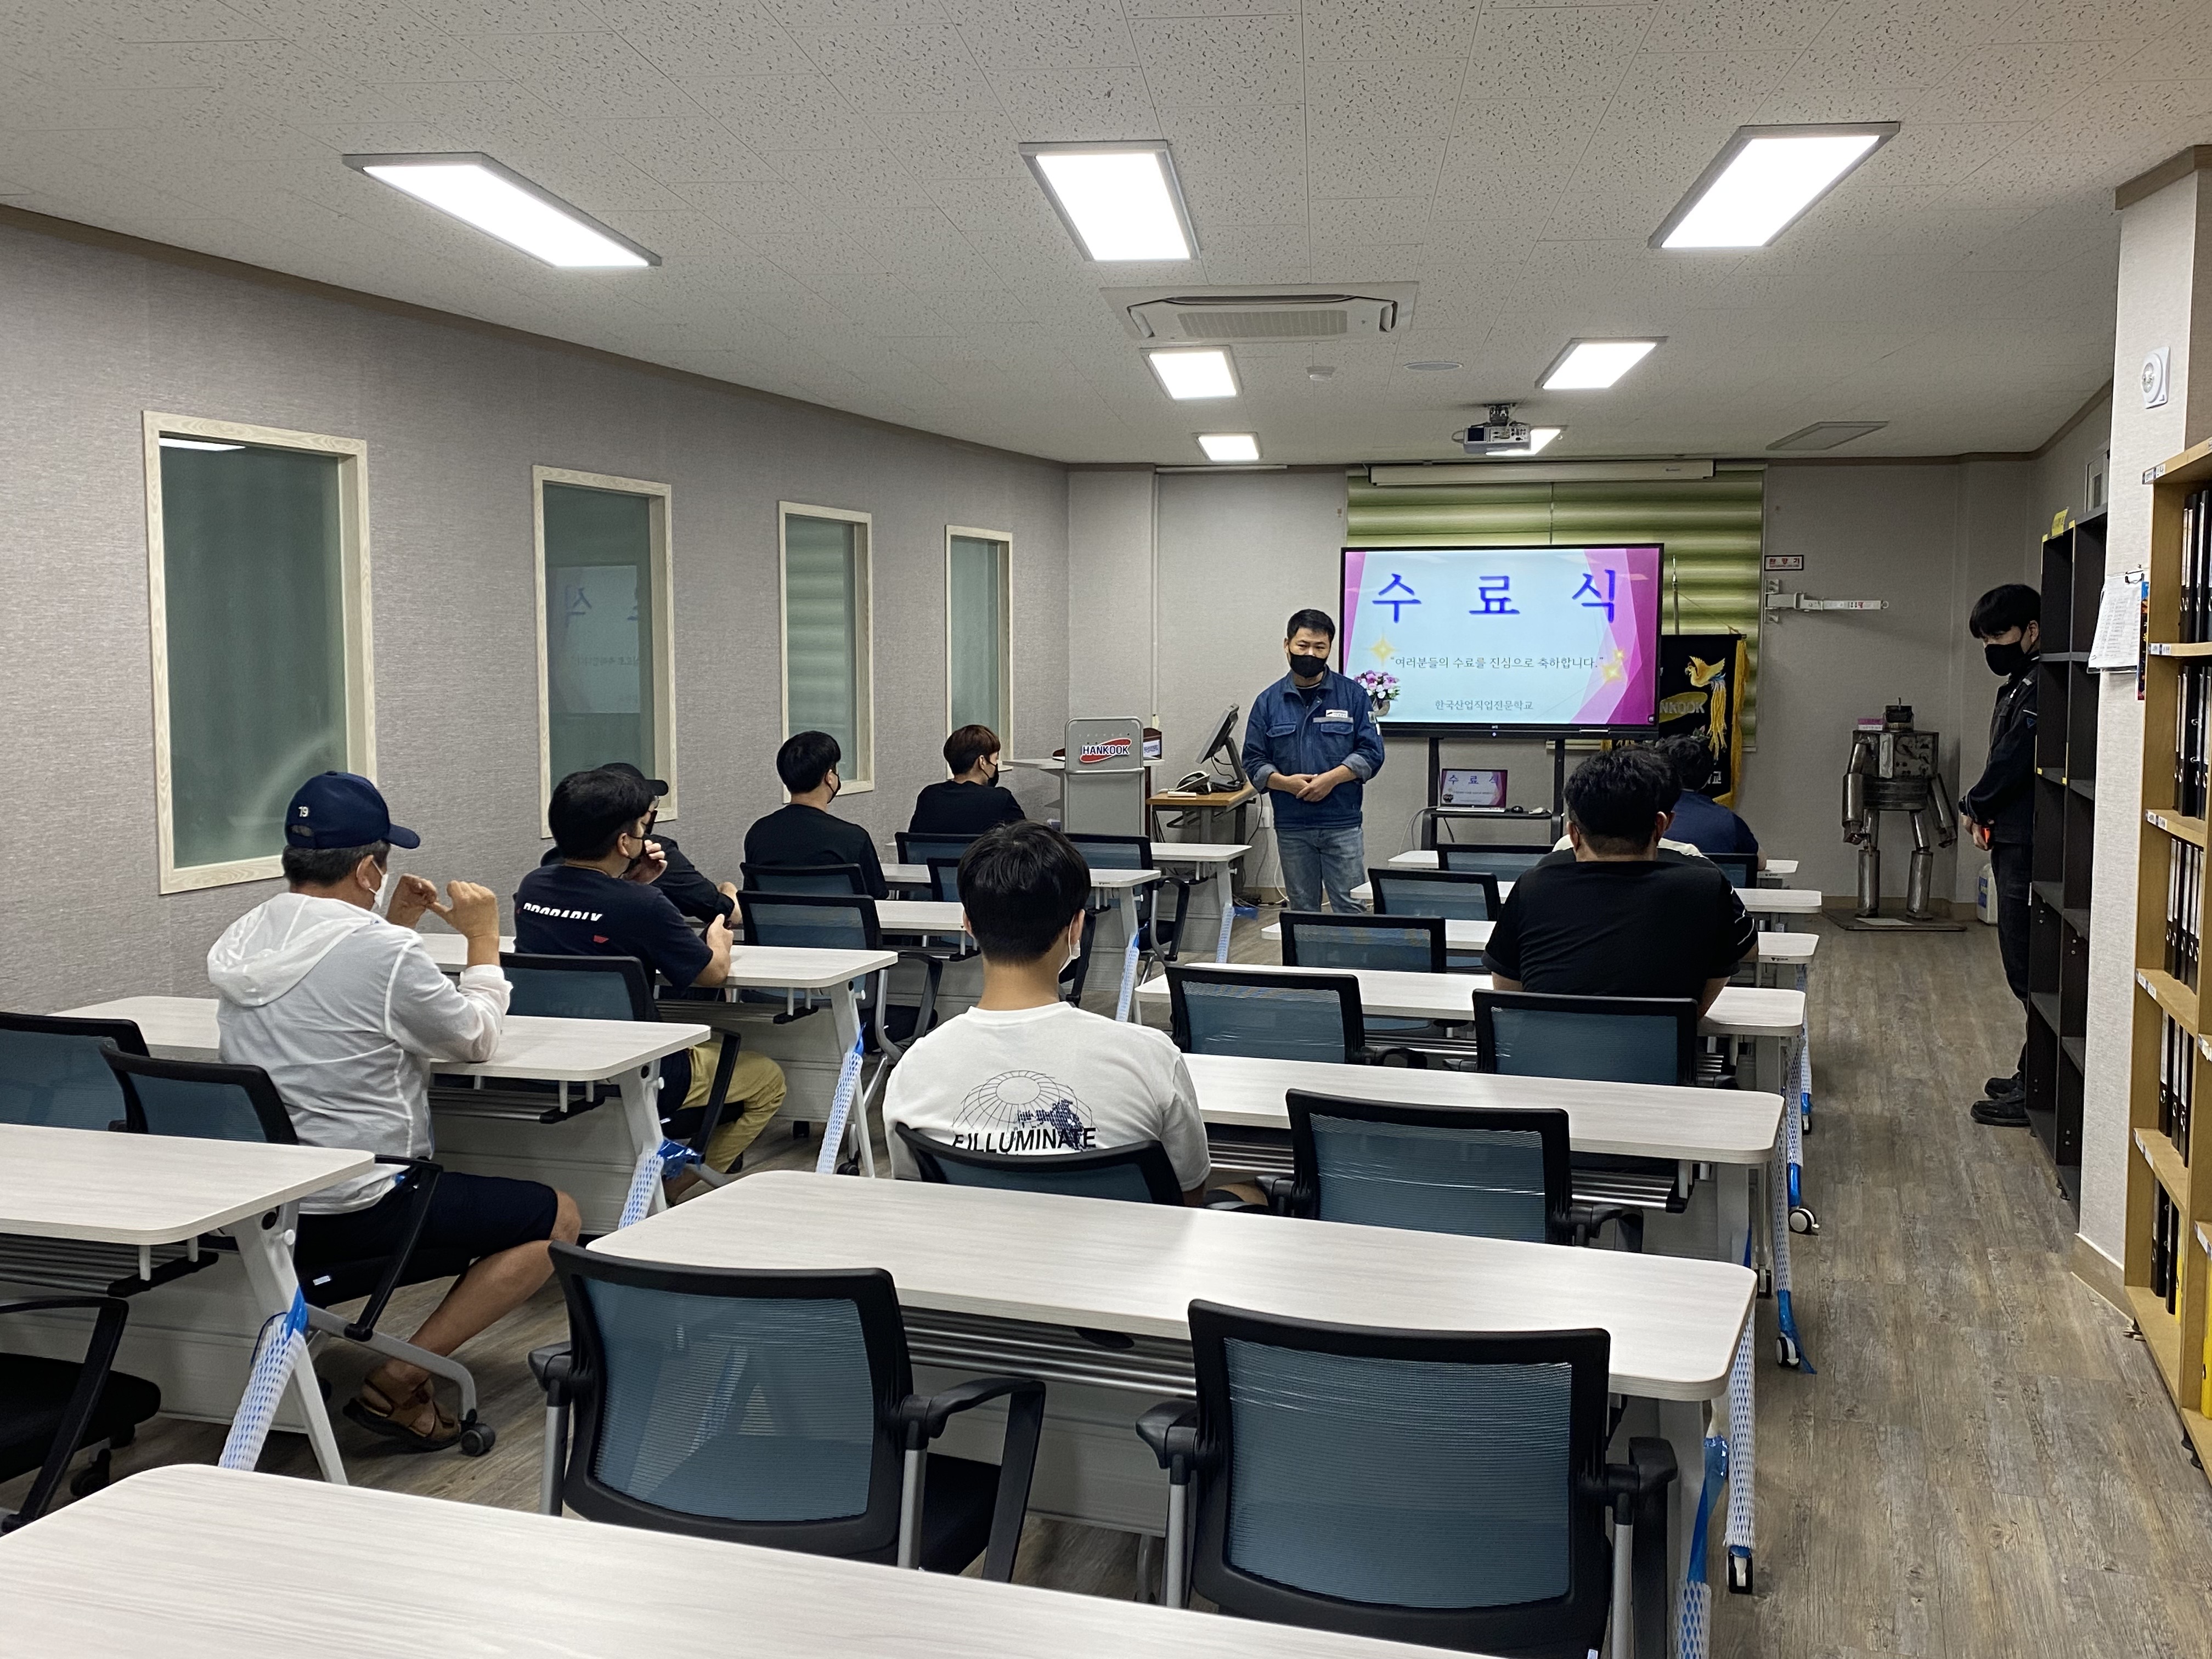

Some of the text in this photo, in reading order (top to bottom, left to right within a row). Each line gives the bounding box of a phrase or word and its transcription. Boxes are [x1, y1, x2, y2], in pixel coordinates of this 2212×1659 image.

[1372, 569, 1617, 624] 수 료 식
[1453, 657, 1486, 669] 수료를
[1490, 657, 1534, 668] 진심으로
[1435, 700, 1533, 710] 한국산업직업전문학교
[1082, 745, 1129, 755] HANKOOK
[1448, 775, 1458, 785] 수
[1468, 775, 1479, 784] 료
